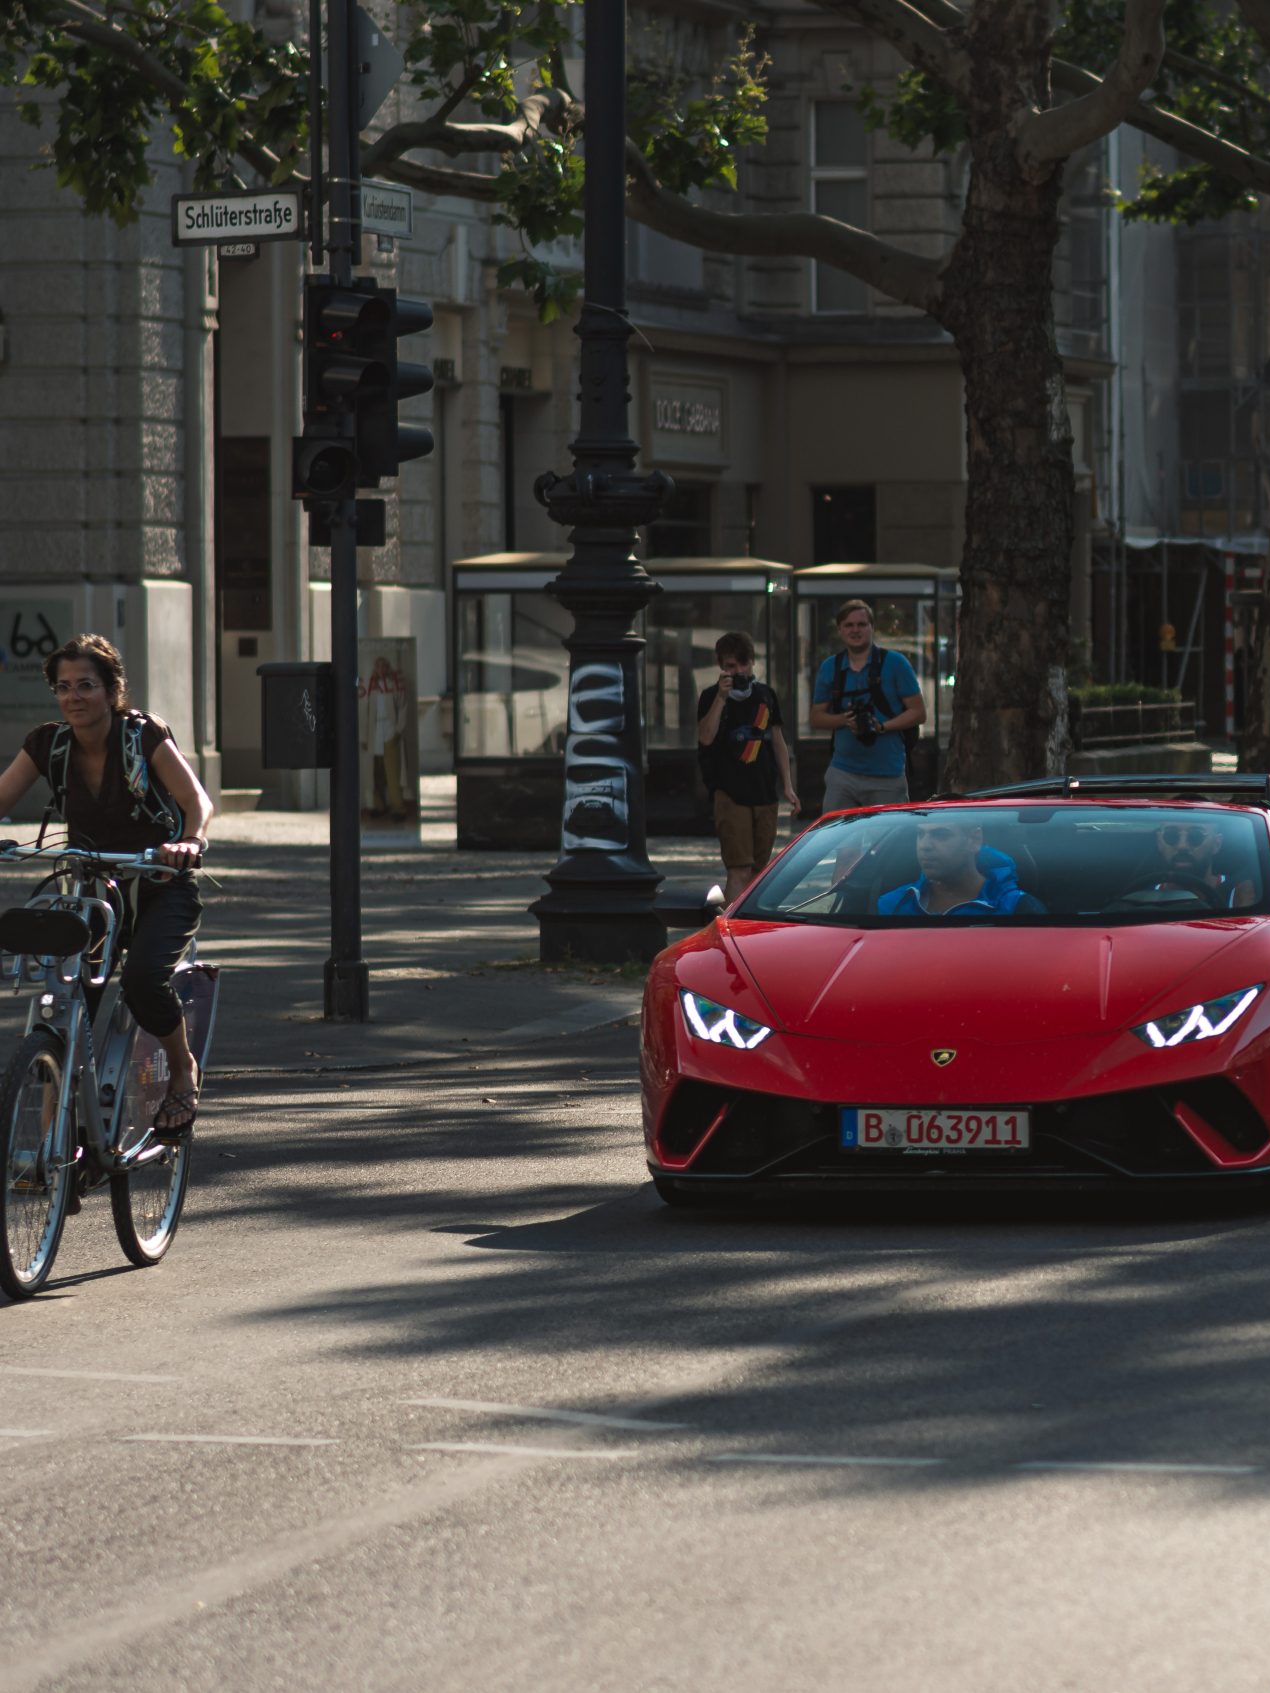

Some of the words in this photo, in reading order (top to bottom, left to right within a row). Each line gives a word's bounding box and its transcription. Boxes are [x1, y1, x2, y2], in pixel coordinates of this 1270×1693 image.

[185, 200, 292, 229] Schlüterstraße
[363, 194, 406, 222] Kurfürstendamm
[226, 244, 252, 254] 42-40
[358, 640, 409, 650] GNONA
[865, 1113, 883, 1143] B
[906, 1114, 1022, 1145] 063911
